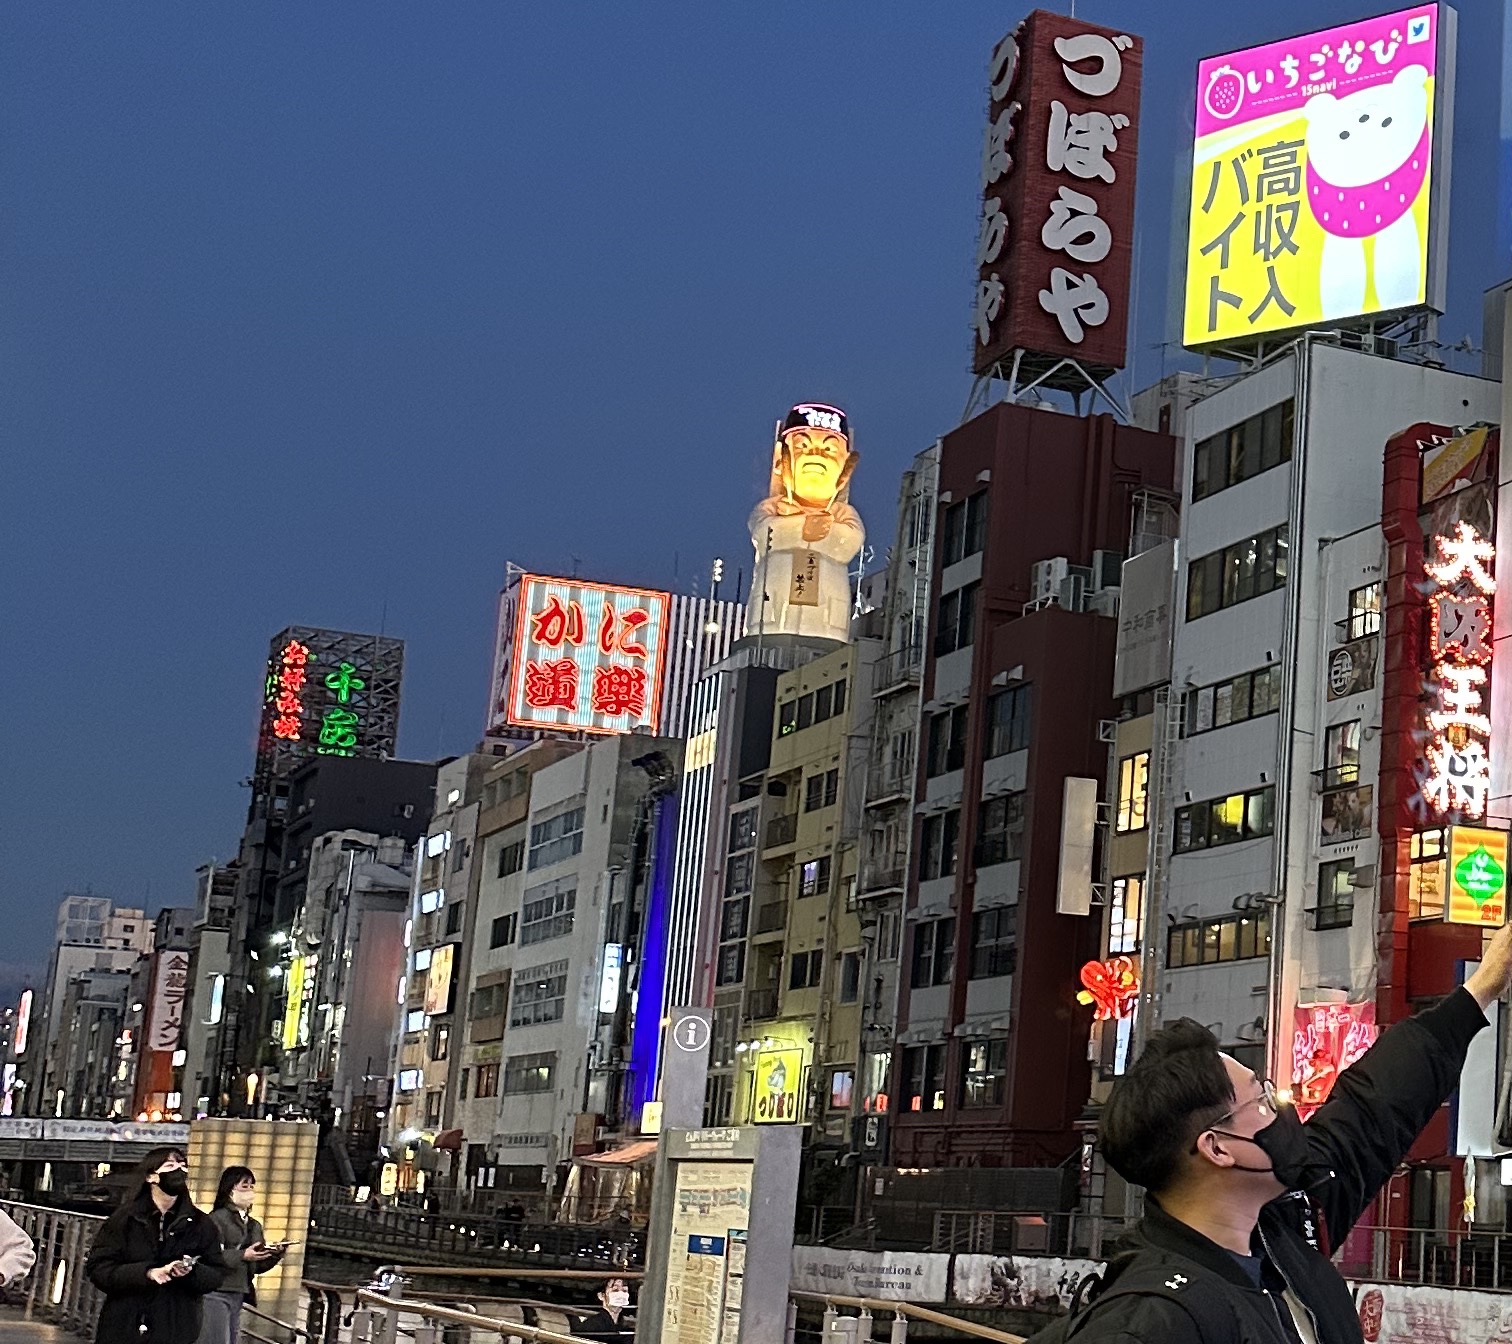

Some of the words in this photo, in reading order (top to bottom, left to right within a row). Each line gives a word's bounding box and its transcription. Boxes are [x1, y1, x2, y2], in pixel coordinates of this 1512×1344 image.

[1247, 27, 1404, 95] いちごなび
[1301, 78, 1337, 98] 15navi
[1039, 33, 1134, 344] づぼらや
[1199, 149, 1254, 332] バイト
[1248, 140, 1305, 324] 高収入
[530, 594, 650, 661] かに
[1423, 519, 1497, 819] 大阪王将
[319, 662, 366, 747] 千房
[1481, 904, 1503, 922] 2F
